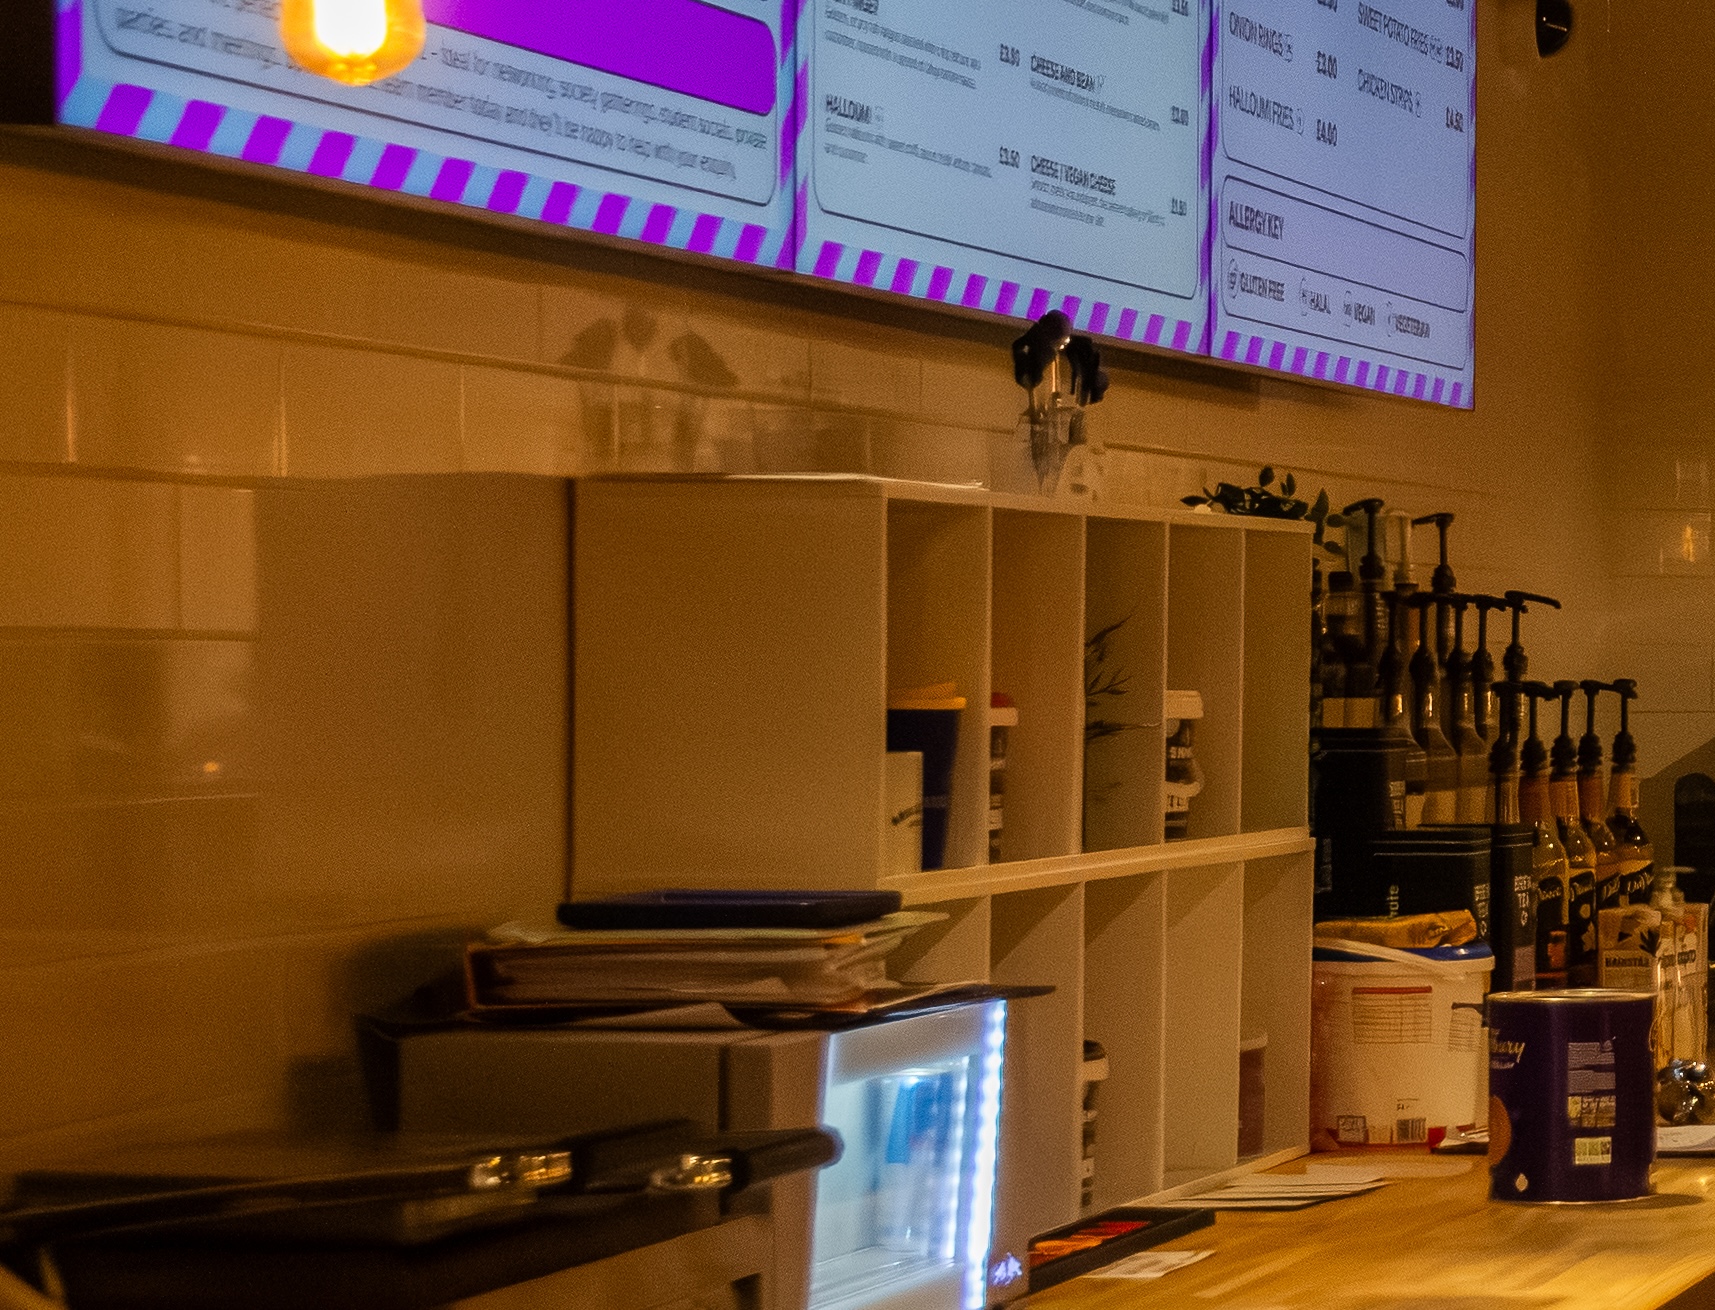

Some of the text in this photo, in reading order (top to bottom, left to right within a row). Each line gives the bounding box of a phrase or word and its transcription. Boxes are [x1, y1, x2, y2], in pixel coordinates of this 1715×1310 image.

[1229, 12, 1257, 42] ONION
[1357, 69, 1391, 102] CHICKEN
[1229, 85, 1272, 124] HALLOUMI
[1272, 100, 1296, 130] FRIES
[1228, 201, 1284, 241] ALLERGY KEY
[1240, 272, 1268, 299] GLUTEN
